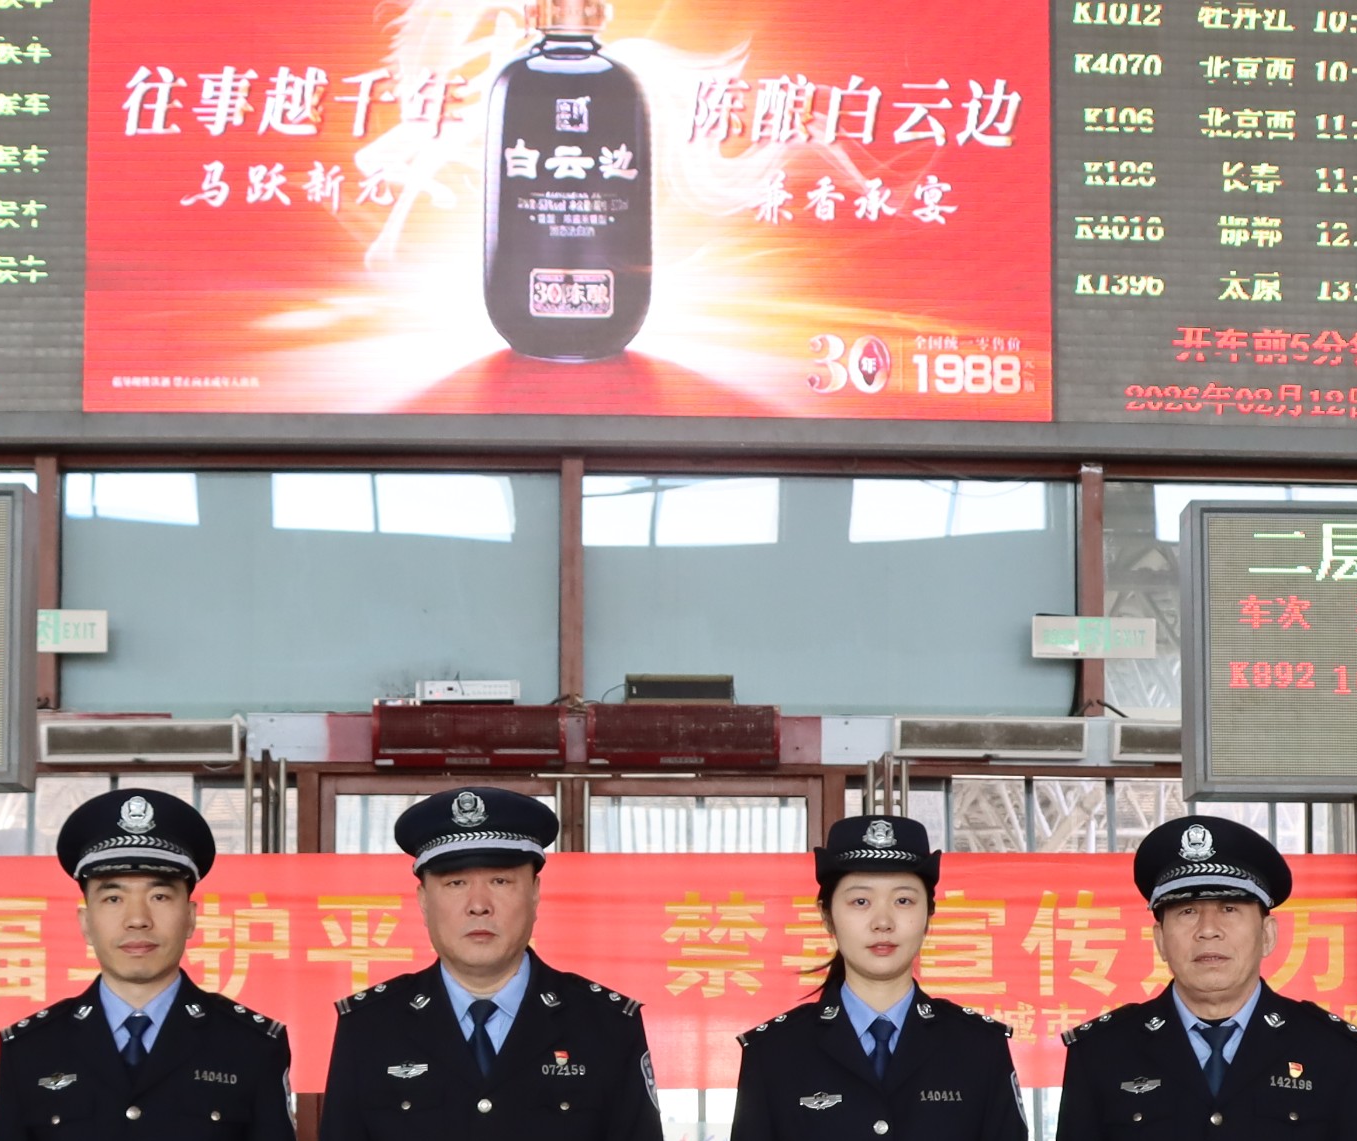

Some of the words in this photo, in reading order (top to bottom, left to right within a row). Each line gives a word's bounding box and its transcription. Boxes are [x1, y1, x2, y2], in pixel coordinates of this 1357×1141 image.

[1072, 2, 1162, 27] K1012
[1197, 2, 1294, 32] 牡丹江
[1074, 53, 1162, 76] K4070
[1199, 55, 1296, 87] 北京西
[120, 64, 466, 142] 往事越千年
[686, 74, 1022, 150] 陈酿白云边
[1198, 107, 1296, 141] 北京西
[504, 138, 639, 180] 白云边
[179, 160, 399, 210] 马跃新元
[1222, 161, 1282, 194] 长春
[754, 176, 959, 226] 兼香承宴
[1217, 215, 1283, 248] 邯郸
[1218, 270, 1282, 302] 太原
[914, 335, 1021, 352] 全国统一零售价
[912, 354, 1022, 393] 1988
[1239, 594, 1311, 630] 车次
[64, 622, 97, 640] EXIT
[1229, 661, 1316, 689] K892
[194, 1070, 237, 1085] 140410
[541, 1065, 586, 1077] 072159
[1270, 1076, 1313, 1090] 142198
[920, 1092, 963, 1103] 140411
